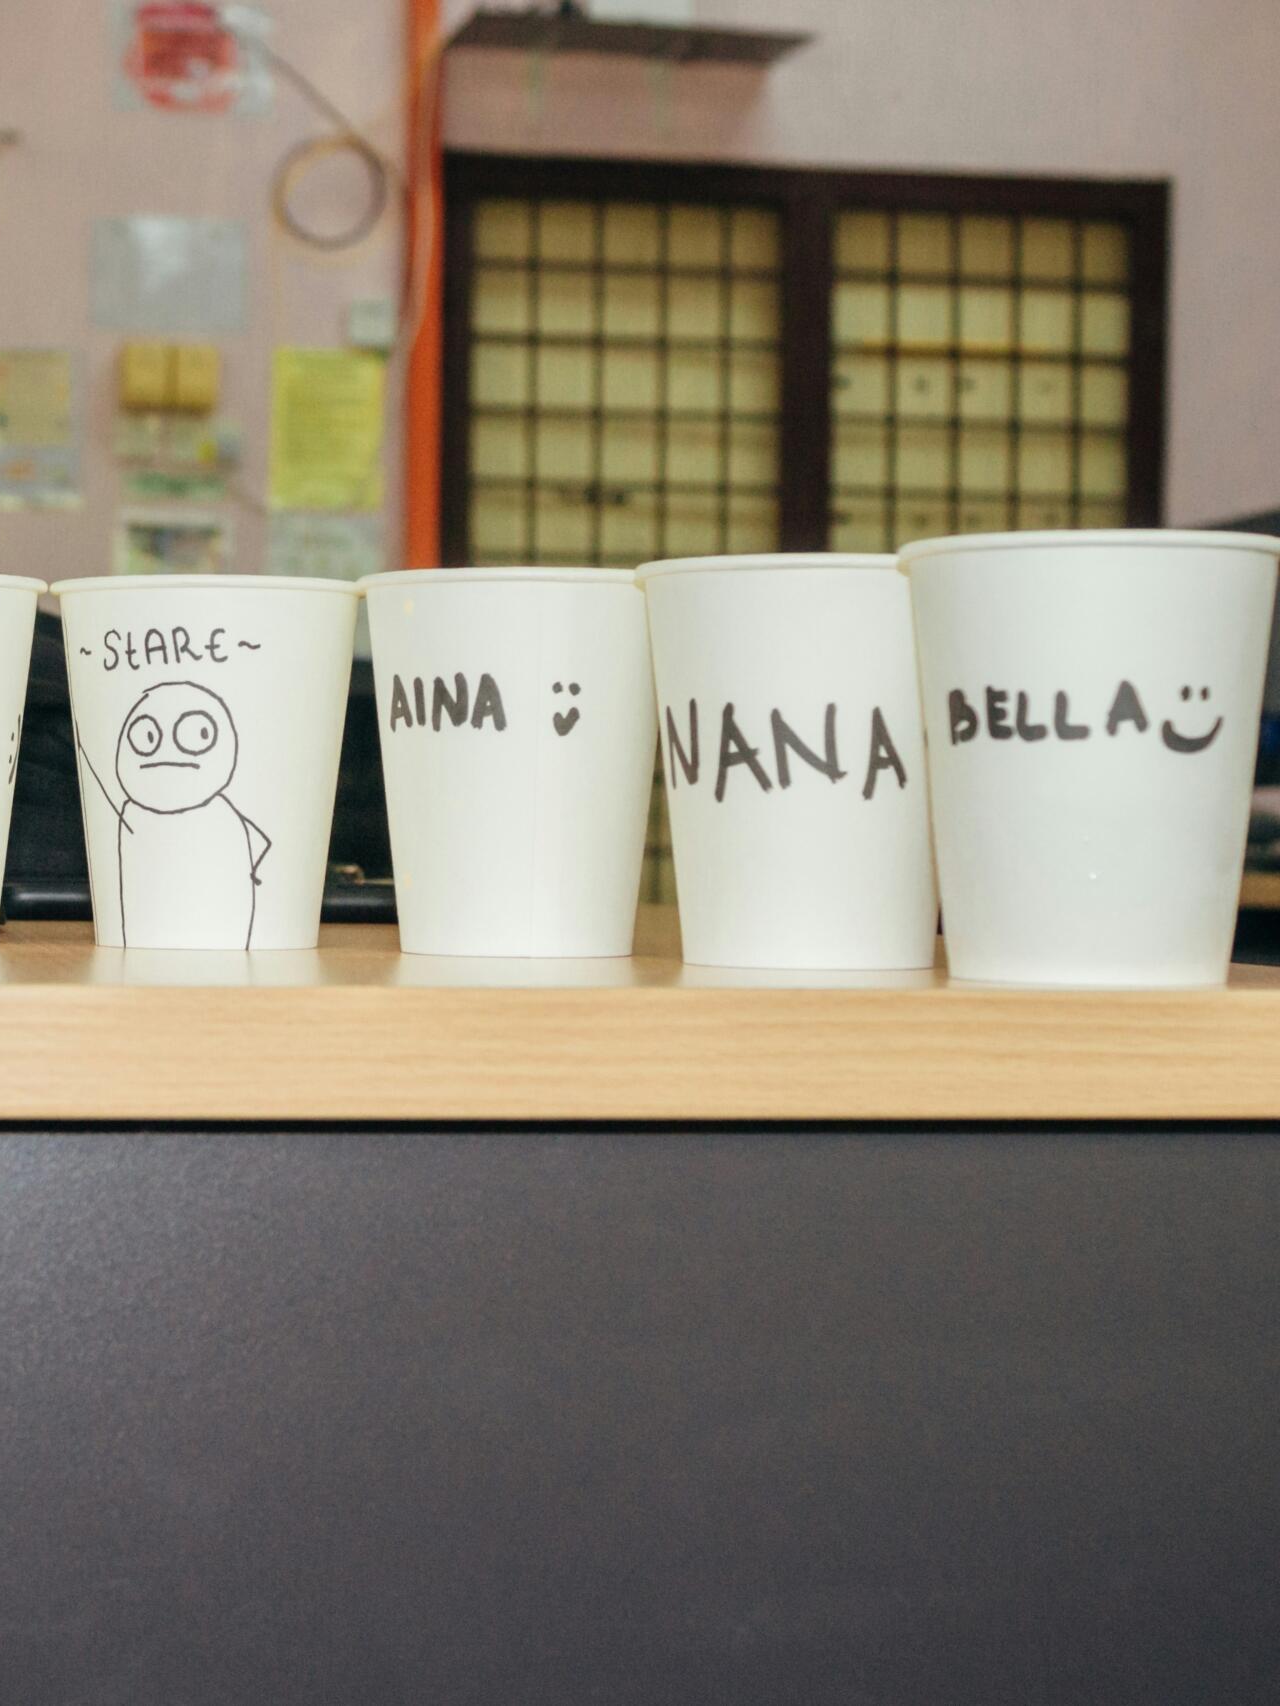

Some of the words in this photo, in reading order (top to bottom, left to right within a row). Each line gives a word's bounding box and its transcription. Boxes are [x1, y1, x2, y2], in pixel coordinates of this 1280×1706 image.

[389, 672, 507, 733] AINA
[947, 680, 1150, 745] BELLA
[665, 697, 908, 803] NANA
